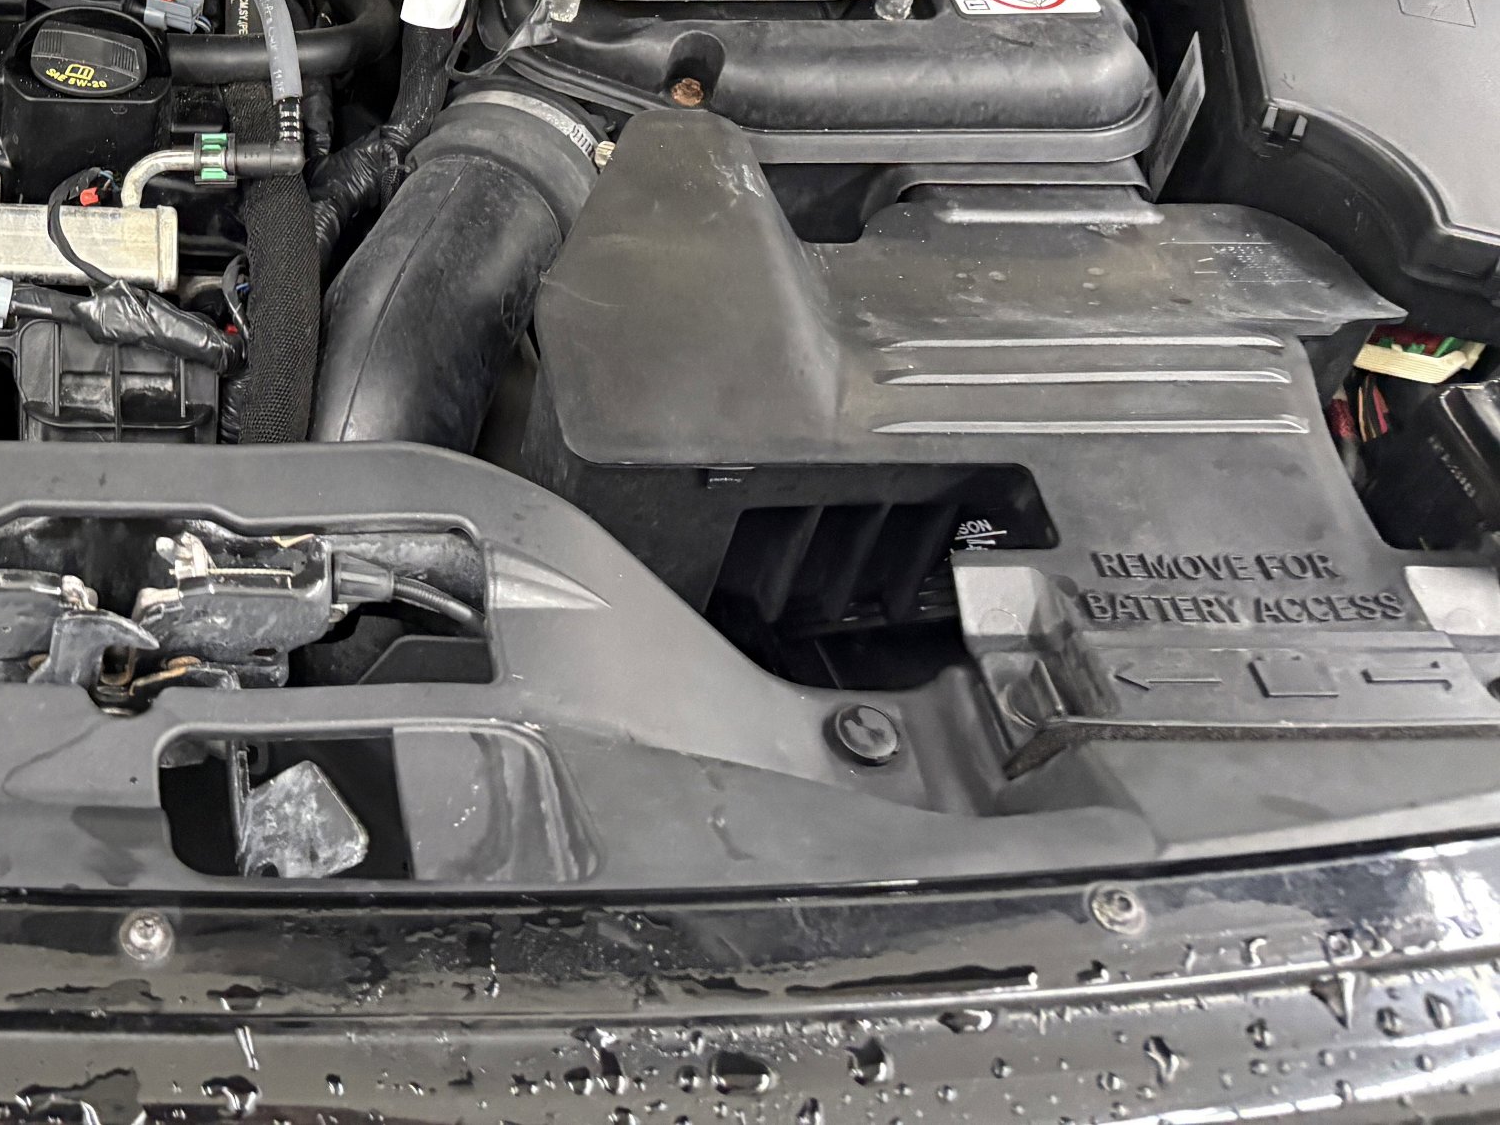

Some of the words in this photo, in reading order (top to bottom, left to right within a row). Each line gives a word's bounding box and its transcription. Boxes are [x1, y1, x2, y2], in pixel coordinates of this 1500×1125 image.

[46, 68, 67, 82] SAE
[68, 78, 107, 88] 5W-20
[1089, 550, 1255, 582] REMOVE
[1253, 549, 1342, 581] FOR
[1079, 592, 1244, 625] BATTERY
[1252, 591, 1407, 624] ACCESS
